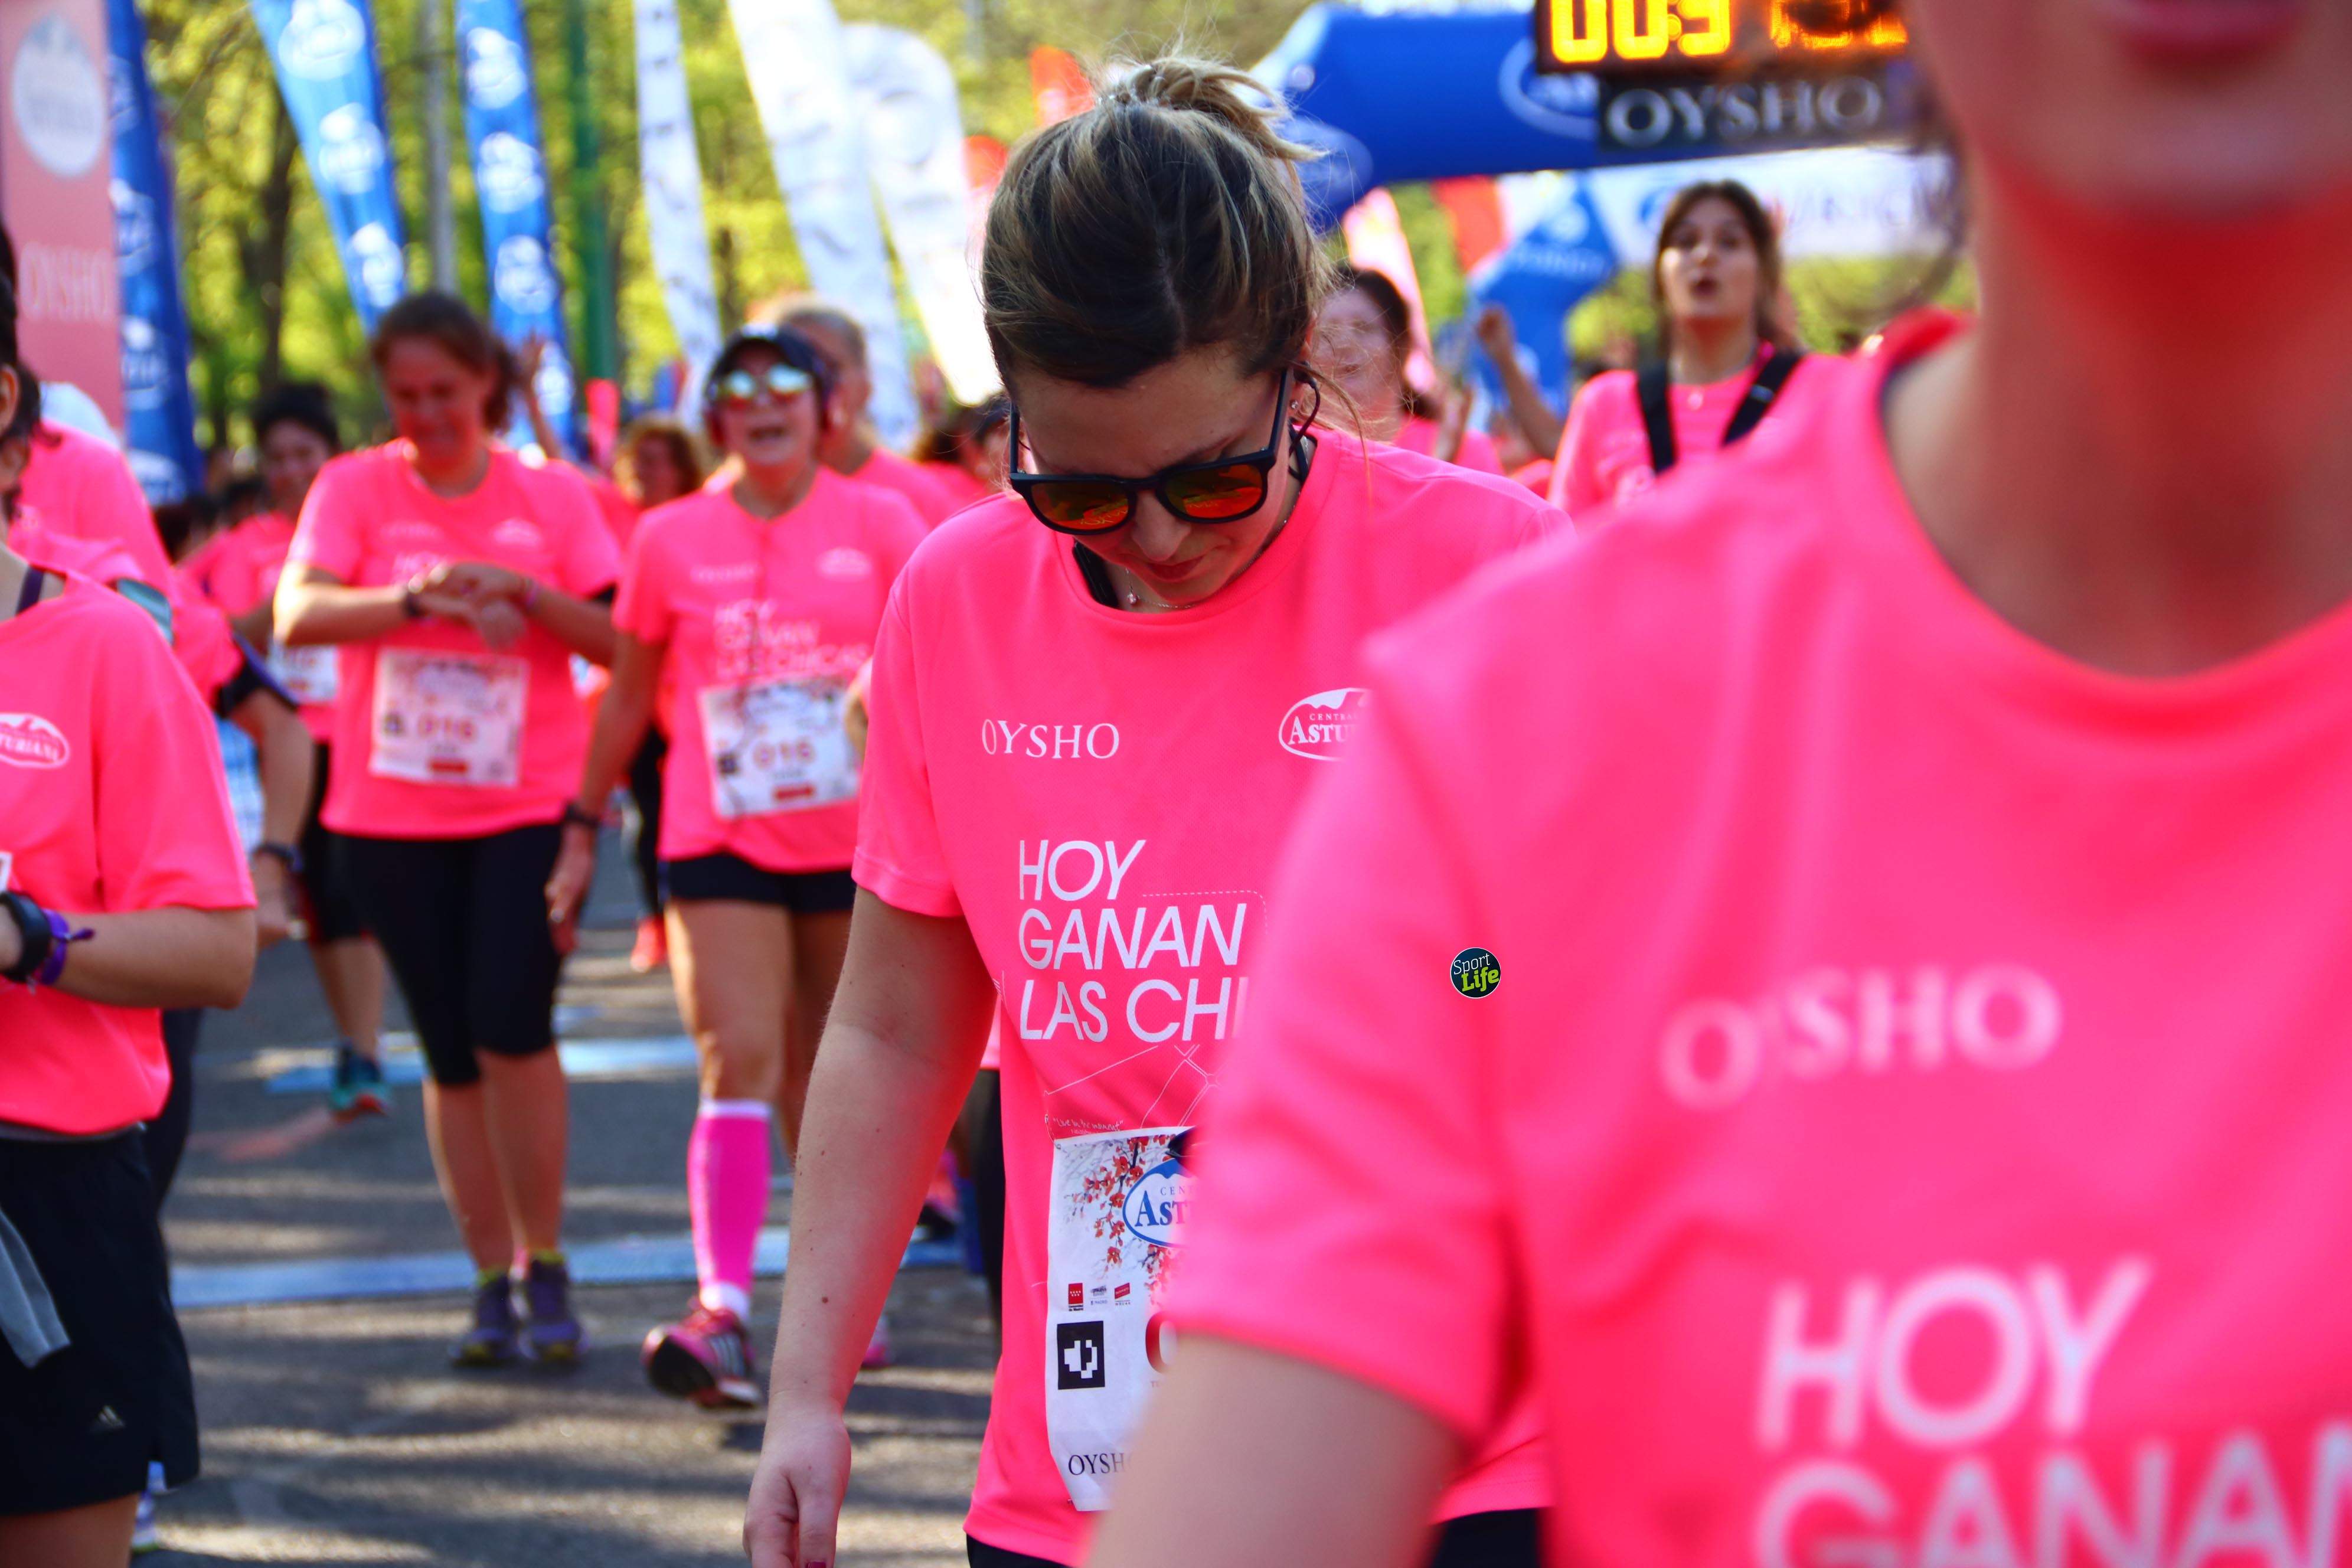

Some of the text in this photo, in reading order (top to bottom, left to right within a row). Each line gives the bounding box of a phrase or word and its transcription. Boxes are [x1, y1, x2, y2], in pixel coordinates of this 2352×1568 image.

[1606, 77, 1881, 146] OYSHO
[982, 718, 1119, 759] OYSHO
[1019, 839, 1146, 901] HOY
[1018, 903, 1247, 970] GANAN
[1020, 979, 1108, 1042] LAS
[1659, 962, 2062, 1111] OSHO
[1161, 1185, 1194, 1196] CEN
[1753, 1255, 2154, 1450] HOY
